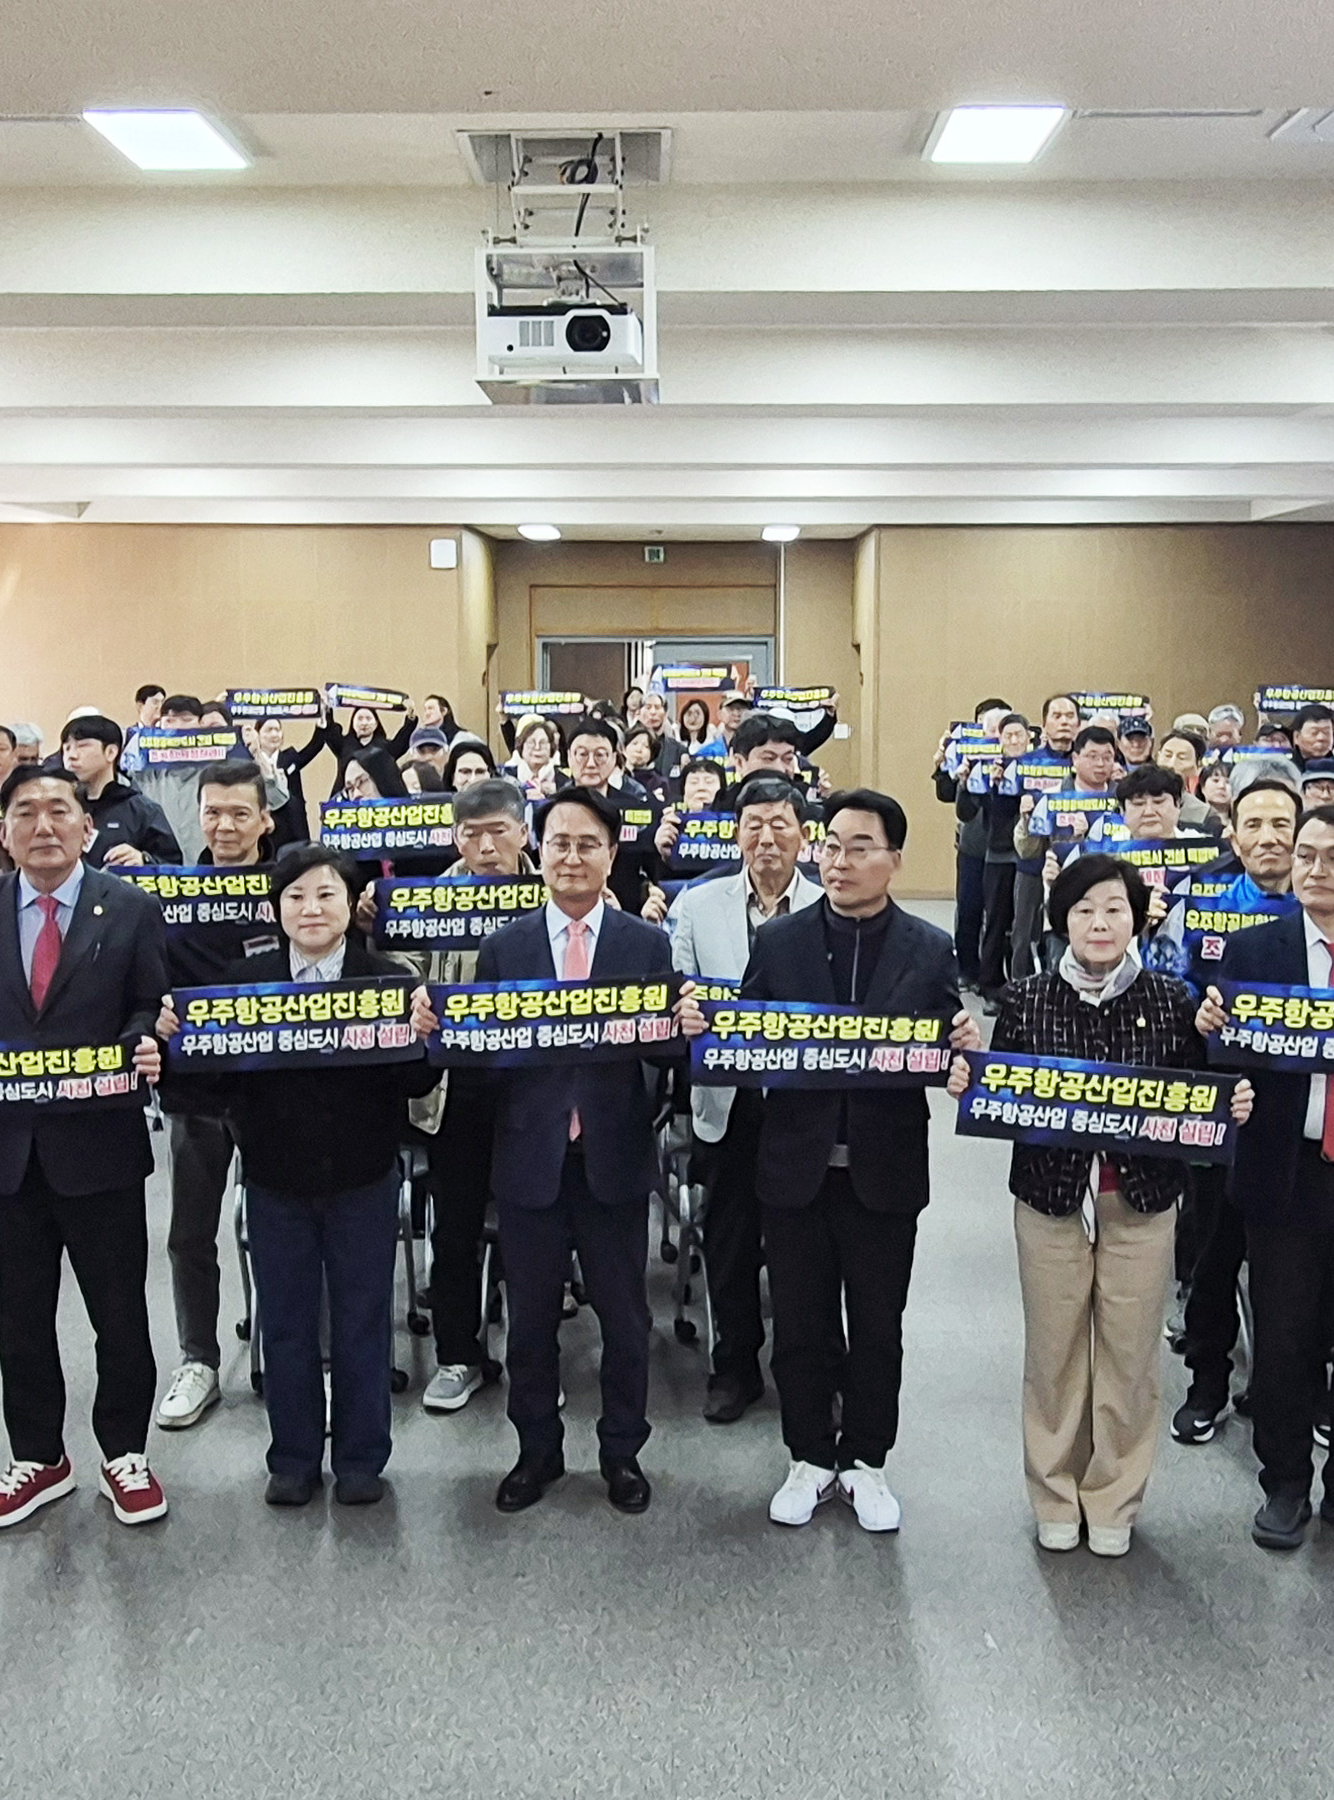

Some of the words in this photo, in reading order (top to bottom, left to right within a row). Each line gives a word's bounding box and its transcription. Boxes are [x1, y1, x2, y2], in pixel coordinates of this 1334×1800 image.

[120, 874, 272, 898] 주항공산업진
[385, 917, 465, 939] 우주항공산업
[186, 987, 404, 1027] 우주항공산업진흥원
[445, 984, 667, 1023] 우주항공산업진흥원
[181, 1031, 273, 1057] 우주항공산업
[277, 1027, 339, 1050] 중심도시
[441, 1026, 533, 1052] 우주항공산업
[536, 1022, 600, 1048] 중심도시
[711, 1010, 941, 1042] 우주항공산업진흥원
[1220, 1026, 1318, 1058] 우주항공산업
[703, 1048, 797, 1071] 우주항공산업
[802, 1047, 866, 1071] 중심도시
[980, 1063, 1218, 1113] 우주항공산업진흥원
[969, 1098, 1067, 1131] 우주항공산업
[1071, 1109, 1138, 1136] 중심도시
